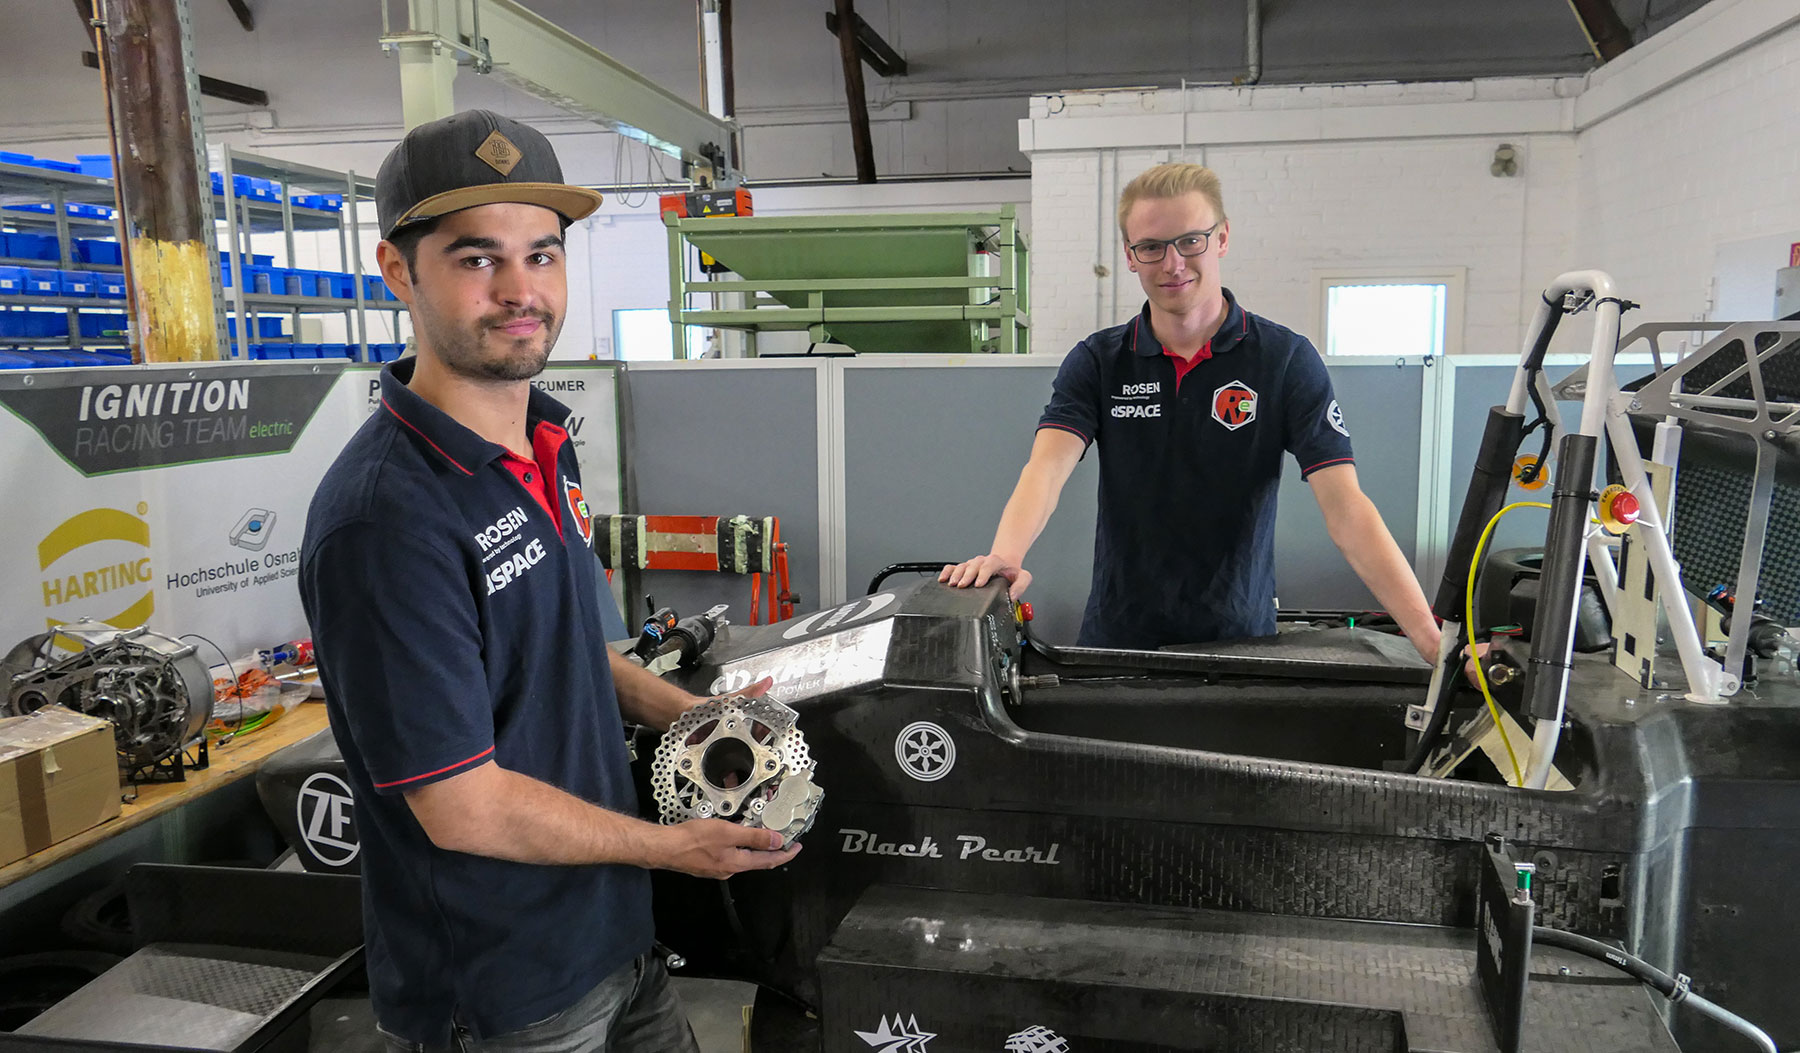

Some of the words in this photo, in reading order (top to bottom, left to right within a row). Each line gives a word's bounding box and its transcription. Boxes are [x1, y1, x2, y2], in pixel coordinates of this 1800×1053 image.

[79, 379, 250, 422] IGNITION
[530, 380, 586, 392] CUMER
[1122, 381, 1160, 395] ROSEN
[1110, 404, 1161, 418] dSPACE
[74, 420, 174, 457] RACING
[181, 415, 247, 445] TEAM
[249, 420, 293, 438] electric
[474, 506, 529, 552] ROSEN
[42, 557, 153, 607] HARTING
[166, 558, 260, 590] Hochschule
[196, 580, 238, 598] University
[240, 577, 249, 588] of
[253, 571, 279, 587] Applied
[280, 566, 299, 580] Scien
[302, 787, 360, 851] ZF
[838, 828, 943, 859] Black
[956, 834, 1060, 865] Pearl
